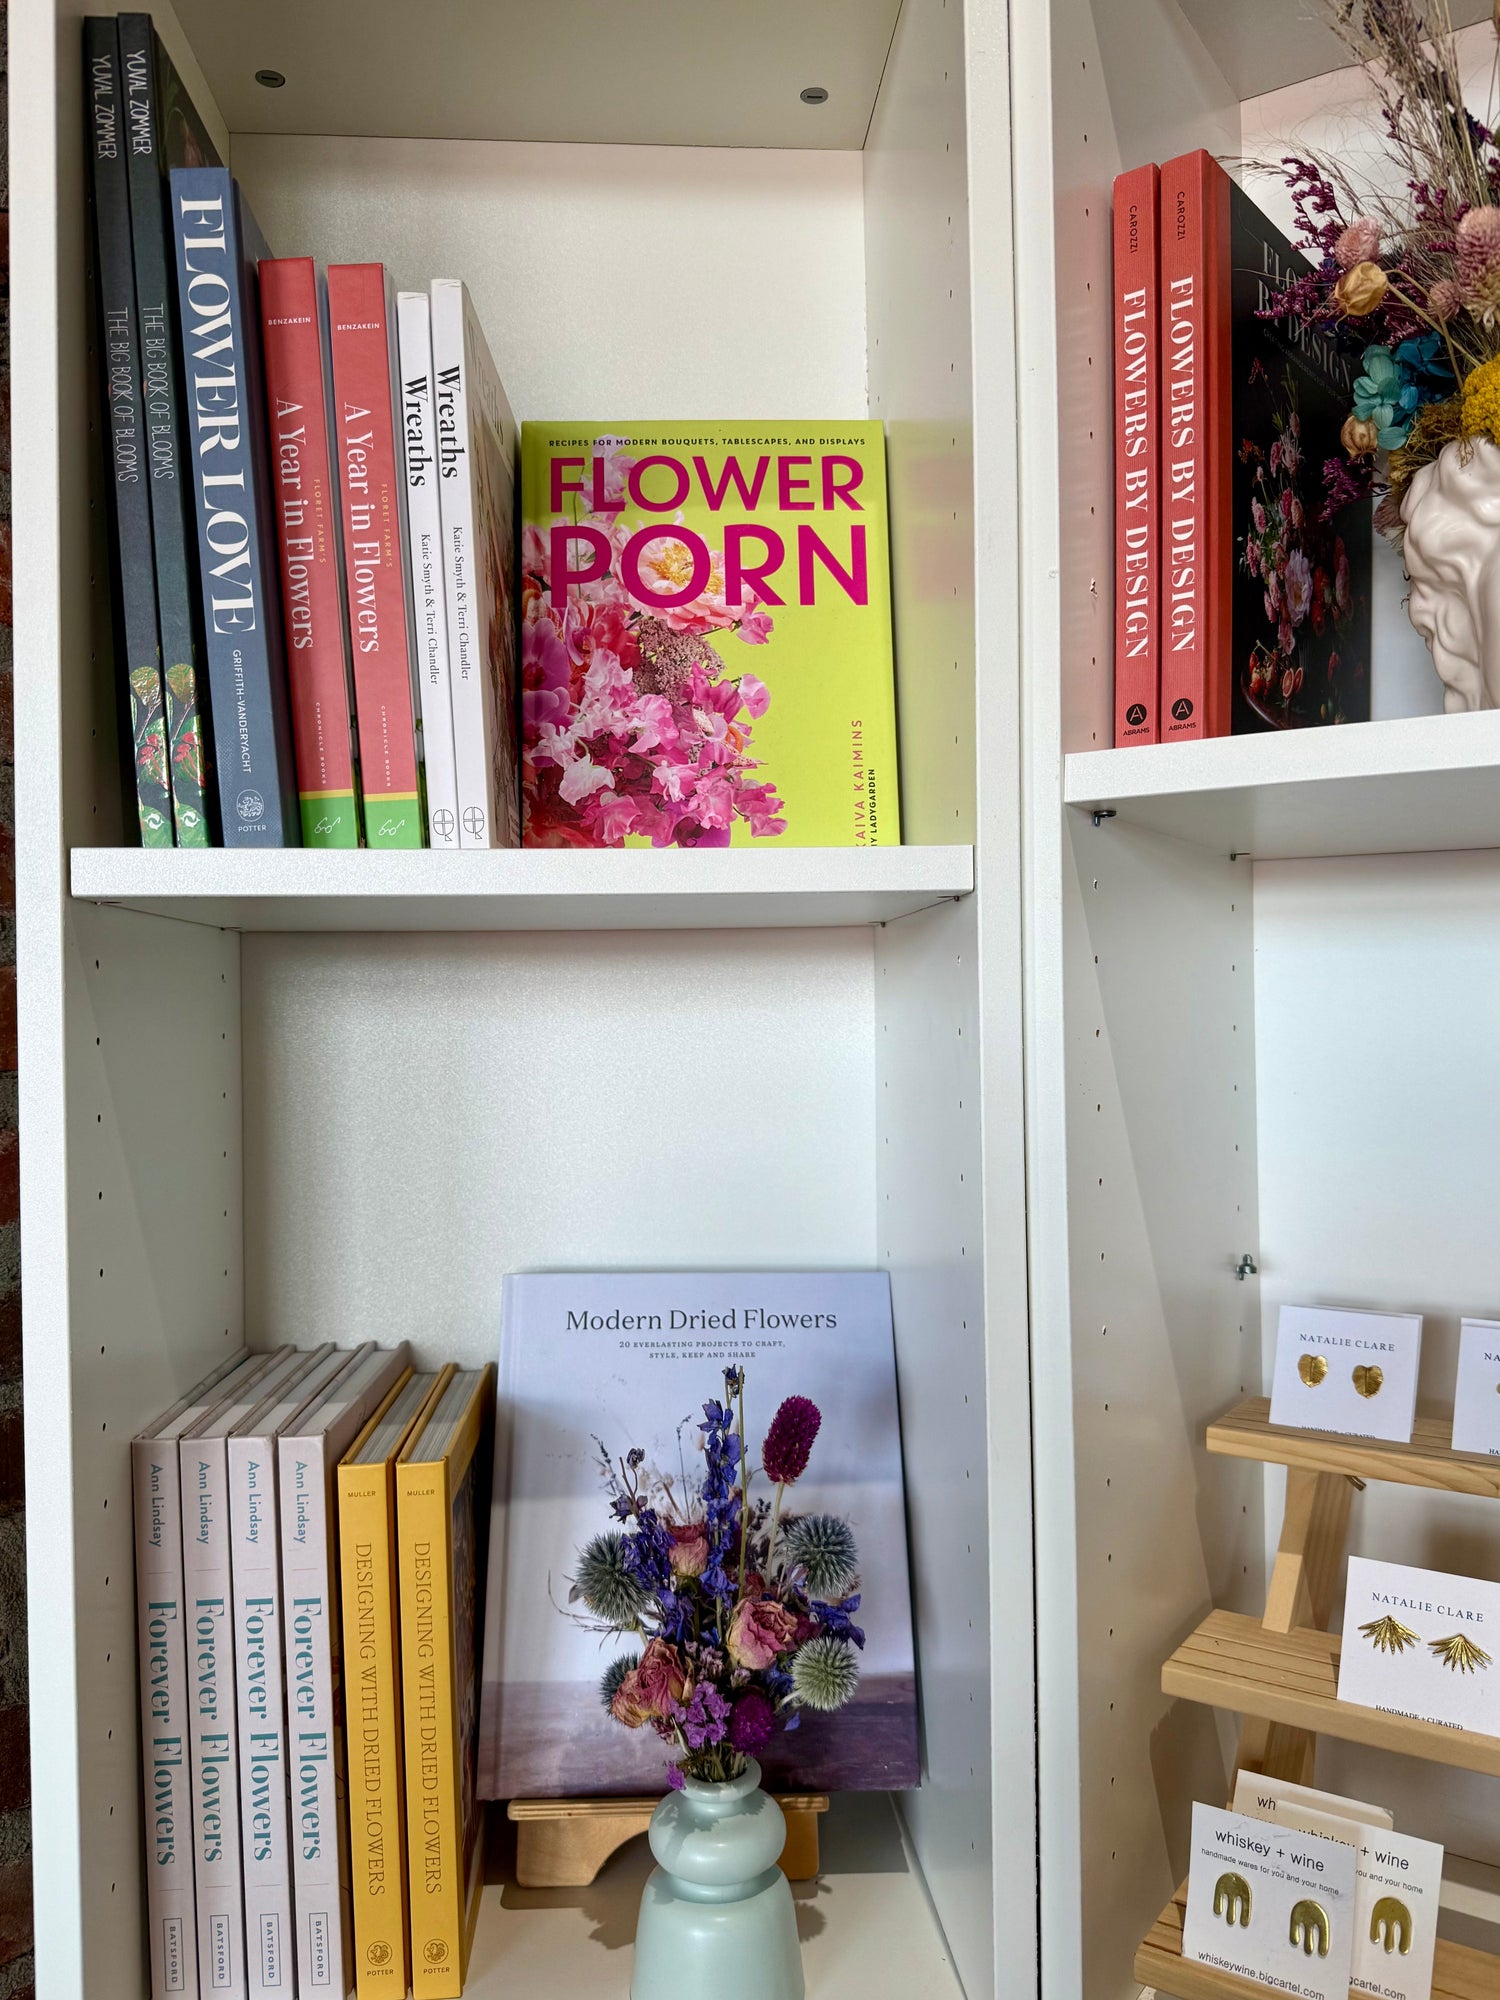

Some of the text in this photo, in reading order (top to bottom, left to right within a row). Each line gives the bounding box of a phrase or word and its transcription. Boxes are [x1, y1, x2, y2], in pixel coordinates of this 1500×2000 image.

[92, 54, 117, 159] YUVAL ZOMMER
[126, 50, 152, 155] YUVAL ZOMMER
[1129, 205, 1138, 254] CAROZZI
[1177, 191, 1185, 241] CAROZZI
[268, 316, 311, 326] BENZAKEIN
[337, 323, 380, 331] BENZAKEIN
[107, 307, 138, 483] THE BIG BOOK OF BLOOMS
[143, 303, 175, 479] THE BIG BOOK OF BLOOMS
[180, 194, 256, 635] FLOWER LOVE
[404, 375, 433, 487] Wreaths
[437, 364, 465, 478] Wreaths
[549, 439, 589, 447] RECIPES
[616, 438, 658, 446] MODERN
[661, 438, 718, 447] BOUQUETS,
[722, 438, 792, 446] TABLESCAPES,
[1123, 286, 1148, 658] FLOWERS BY DESIGN
[1170, 275, 1195, 652] FLOWERS BY DESIGN
[276, 397, 314, 649] A Year in Flowers
[313, 479, 323, 518] FLORET
[381, 483, 390, 523] FLORET
[550, 455, 865, 513] FLOWER
[344, 401, 381, 653] A Year in Flowers
[550, 524, 869, 609] PORN
[421, 534, 440, 685] Katie Smyth & Terri Chandler
[453, 527, 471, 680] Katie Smyth & Terri Chandler
[232, 649, 252, 774] GRIFFITH-VANDERYACHT
[1123, 727, 1150, 736] ABRAMS
[1168, 722, 1197, 731] ABRAMS
[851, 720, 866, 847] AIVA KAIMINS
[868, 769, 878, 847] Y LADYGARDEN
[238, 824, 267, 833] POTTER
[566, 1308, 837, 1331] Modern Dried Flowers
[1299, 1333, 1395, 1352] NATALIE CLARE
[149, 1464, 165, 1547] Ann Lindsay
[196, 1461, 213, 1544] Ann Lindsay
[246, 1460, 262, 1544] Ann Lindsay
[293, 1460, 310, 1544] Ann Lindsay
[348, 1490, 376, 1498] MULLER
[1372, 1592, 1484, 1622] NATALIE CLARE
[149, 1600, 183, 1865] Forever Flowers
[196, 1596, 230, 1862] Forever Flowers
[245, 1596, 279, 1861] Forever Flowers
[293, 1595, 328, 1860] Forever Flowers
[355, 1542, 385, 1896] DESIGNING WITH DRIED FLOWERS
[414, 1541, 442, 1894] DESIGNING WITH DRIED FLOWERS
[1375, 1704, 1420, 1721] HANDMADE
[1427, 1717, 1463, 1731] CURATED
[1201, 1847, 1339, 1896] handmade wares for you and your home
[1215, 1830, 1324, 1872] whiskey + wine
[1360, 1846, 1409, 1870] + wine
[1369, 1873, 1383, 1882] and
[1384, 1877, 1401, 1888] your
[1402, 1882, 1423, 1894] home
[169, 1926, 177, 1984] BATSFORD
[216, 1923, 225, 1980] BATSFORD
[266, 1921, 274, 1979] BATSFORD
[315, 1920, 324, 1978] BATSFORD
[1198, 1951, 1325, 2000] whiskeywine.bigcartel.com
